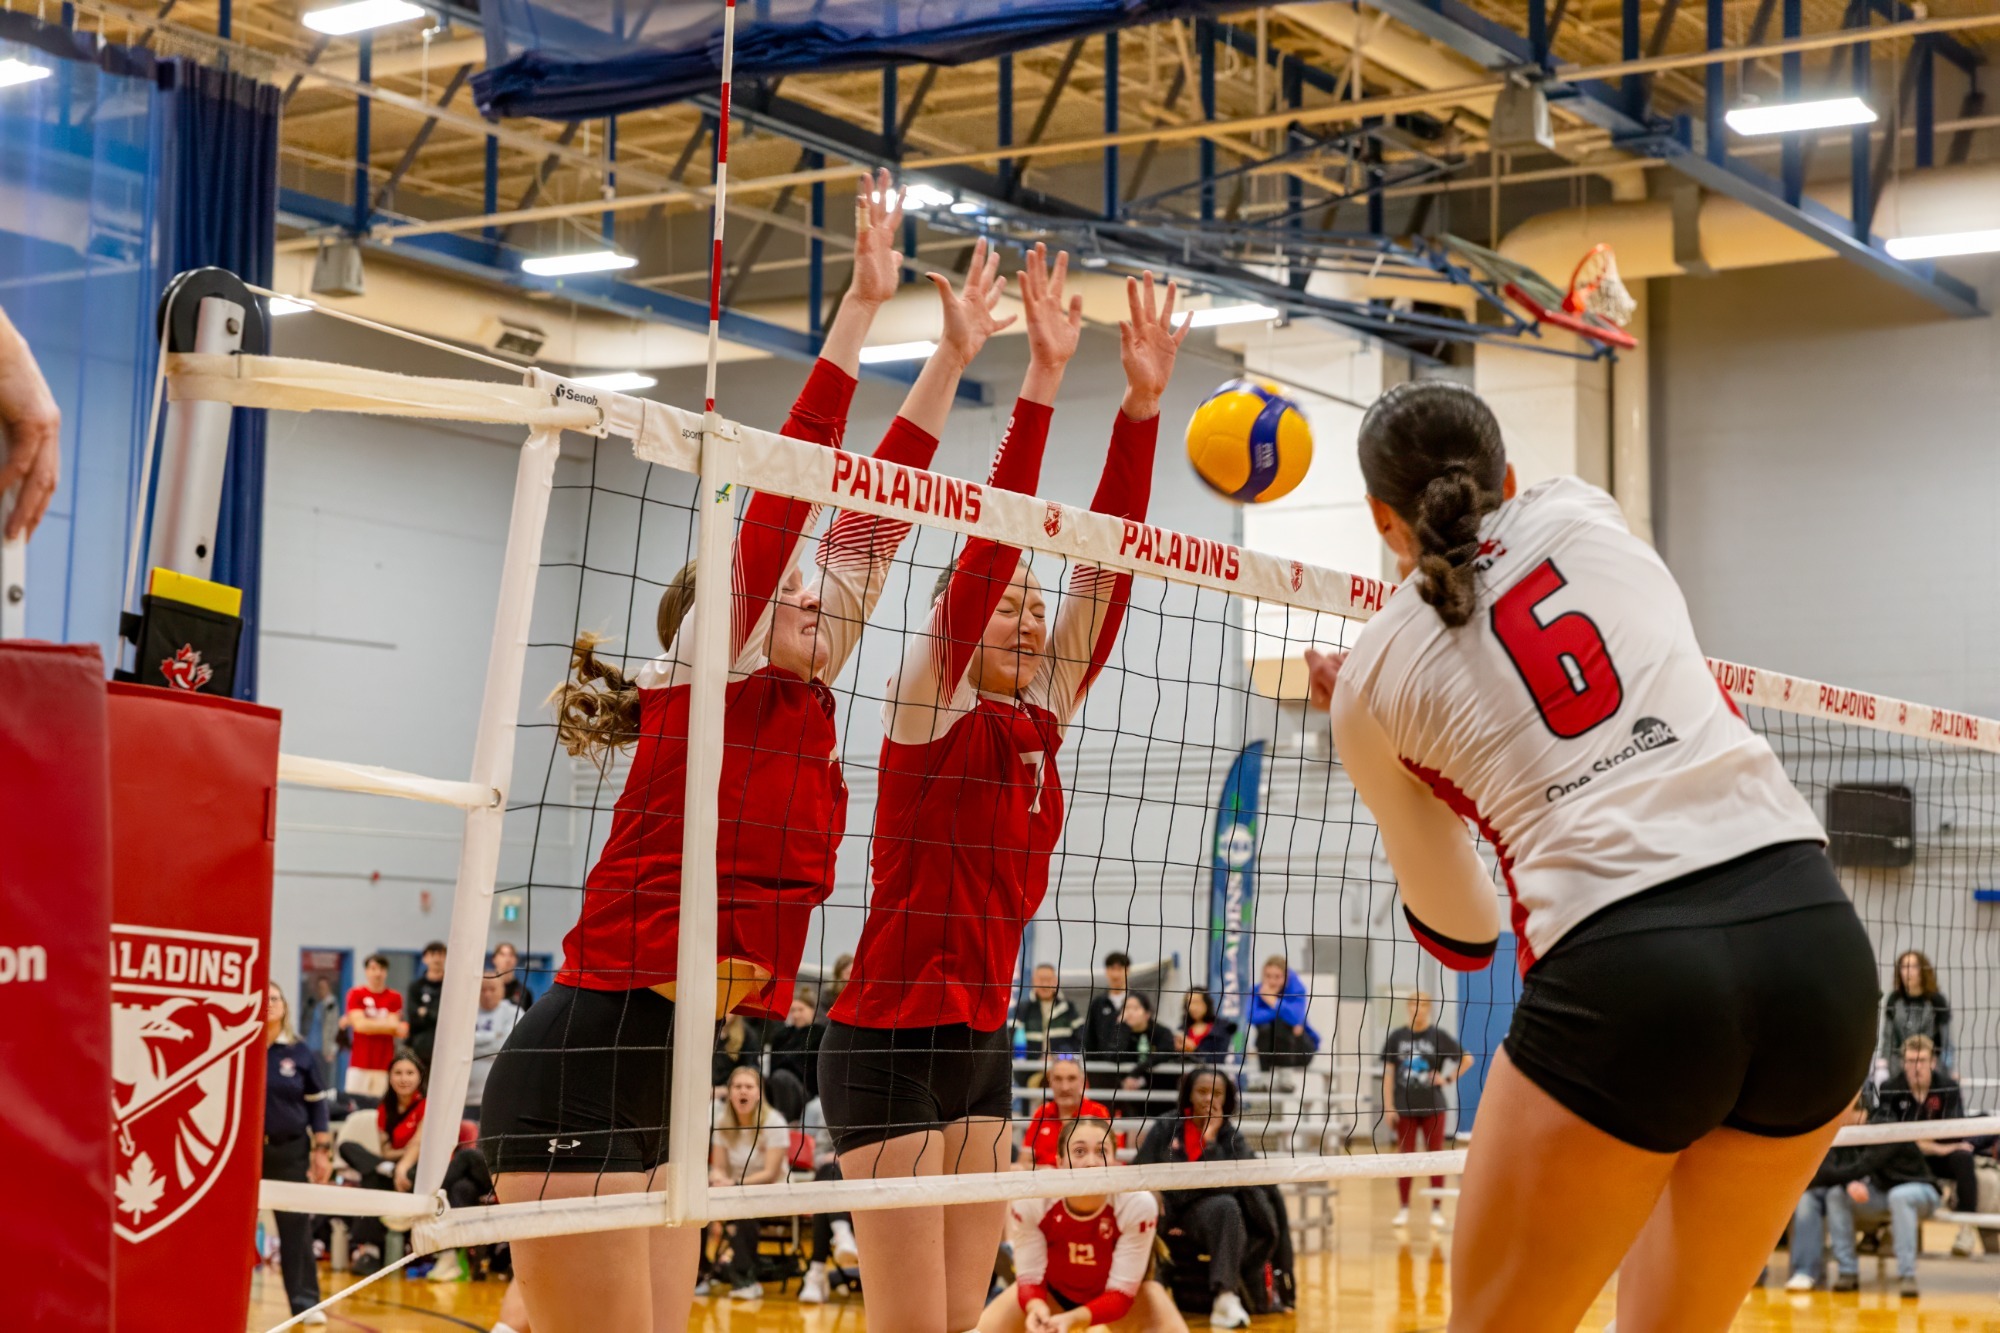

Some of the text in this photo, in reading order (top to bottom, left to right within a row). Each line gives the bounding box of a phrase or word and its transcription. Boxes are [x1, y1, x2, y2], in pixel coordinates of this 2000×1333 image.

[566, 389, 598, 406] Senoh
[831, 449, 983, 524] PALADINS
[1119, 519, 1240, 581] PALADINS
[1490, 557, 1624, 740] 6
[1818, 684, 1876, 721] PALADINS
[1930, 708, 1979, 741] PALADINS
[1018, 750, 1046, 814] 7
[1068, 1241, 1097, 1266] 12
